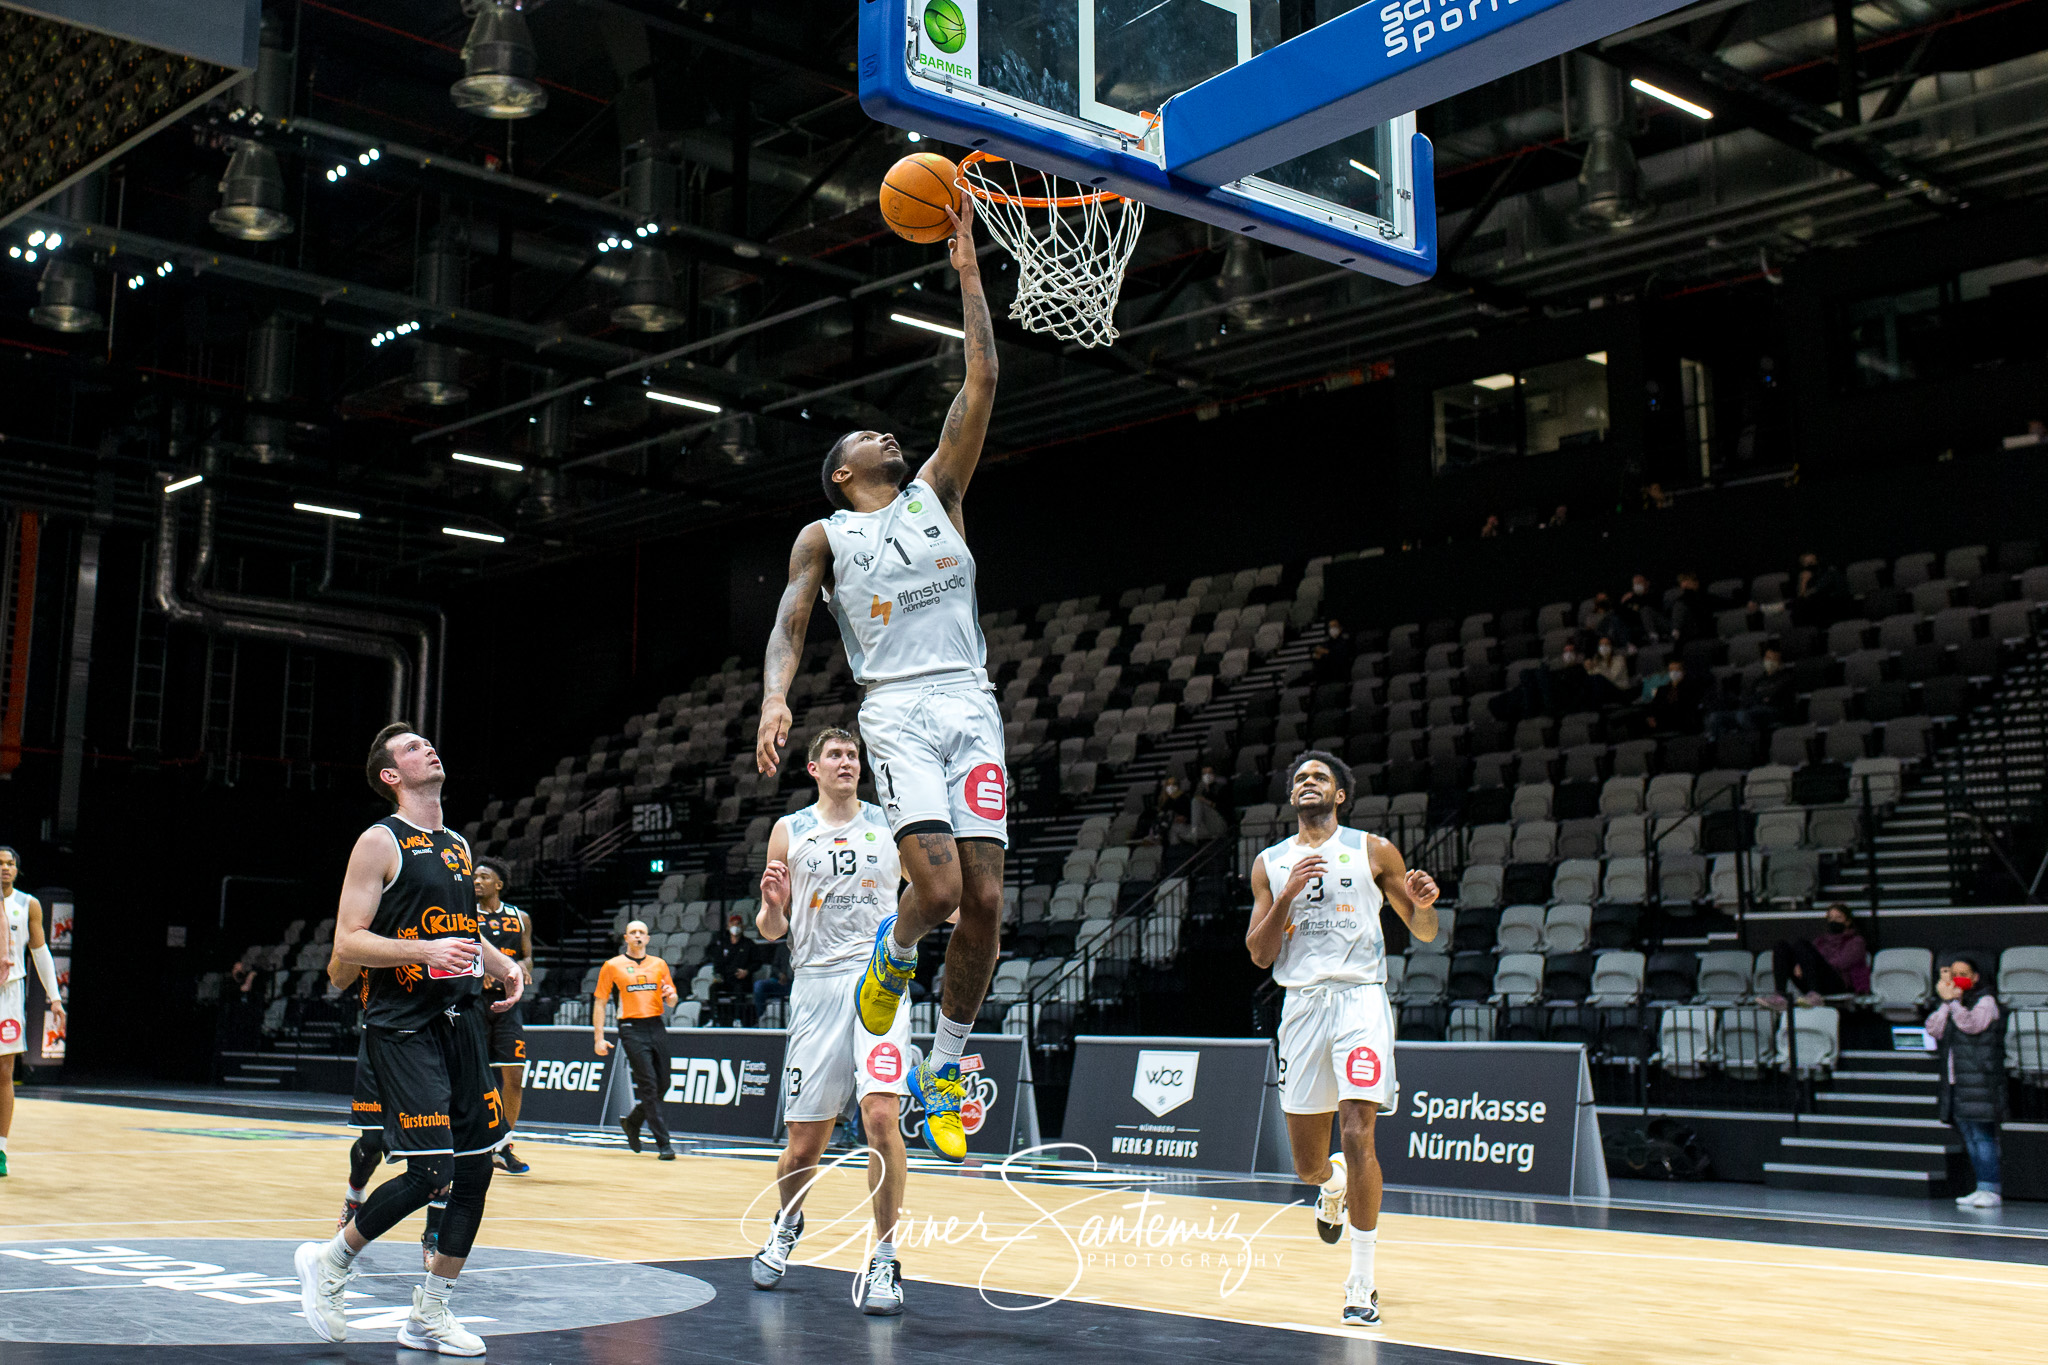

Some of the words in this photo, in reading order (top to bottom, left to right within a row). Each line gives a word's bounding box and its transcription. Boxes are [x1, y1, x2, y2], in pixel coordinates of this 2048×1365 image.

[919, 53, 972, 79] BARMER
[885, 536, 912, 566] 1
[897, 574, 966, 607] filmstudio
[902, 596, 940, 614] nürnberg
[880, 763, 895, 799] 1
[828, 849, 857, 876] 13
[825, 892, 879, 905] filmstudio
[1306, 876, 1325, 902] 3
[501, 917, 521, 933] 23
[1300, 917, 1358, 930] filmstudio
[663, 1057, 737, 1105] EMS
[1411, 1090, 1547, 1125] Sparkasse
[1138, 1123, 1175, 1134] NÜRNBERG
[1154, 1139, 1199, 1158] EVENTS
[1408, 1131, 1535, 1172] Nürnberg
